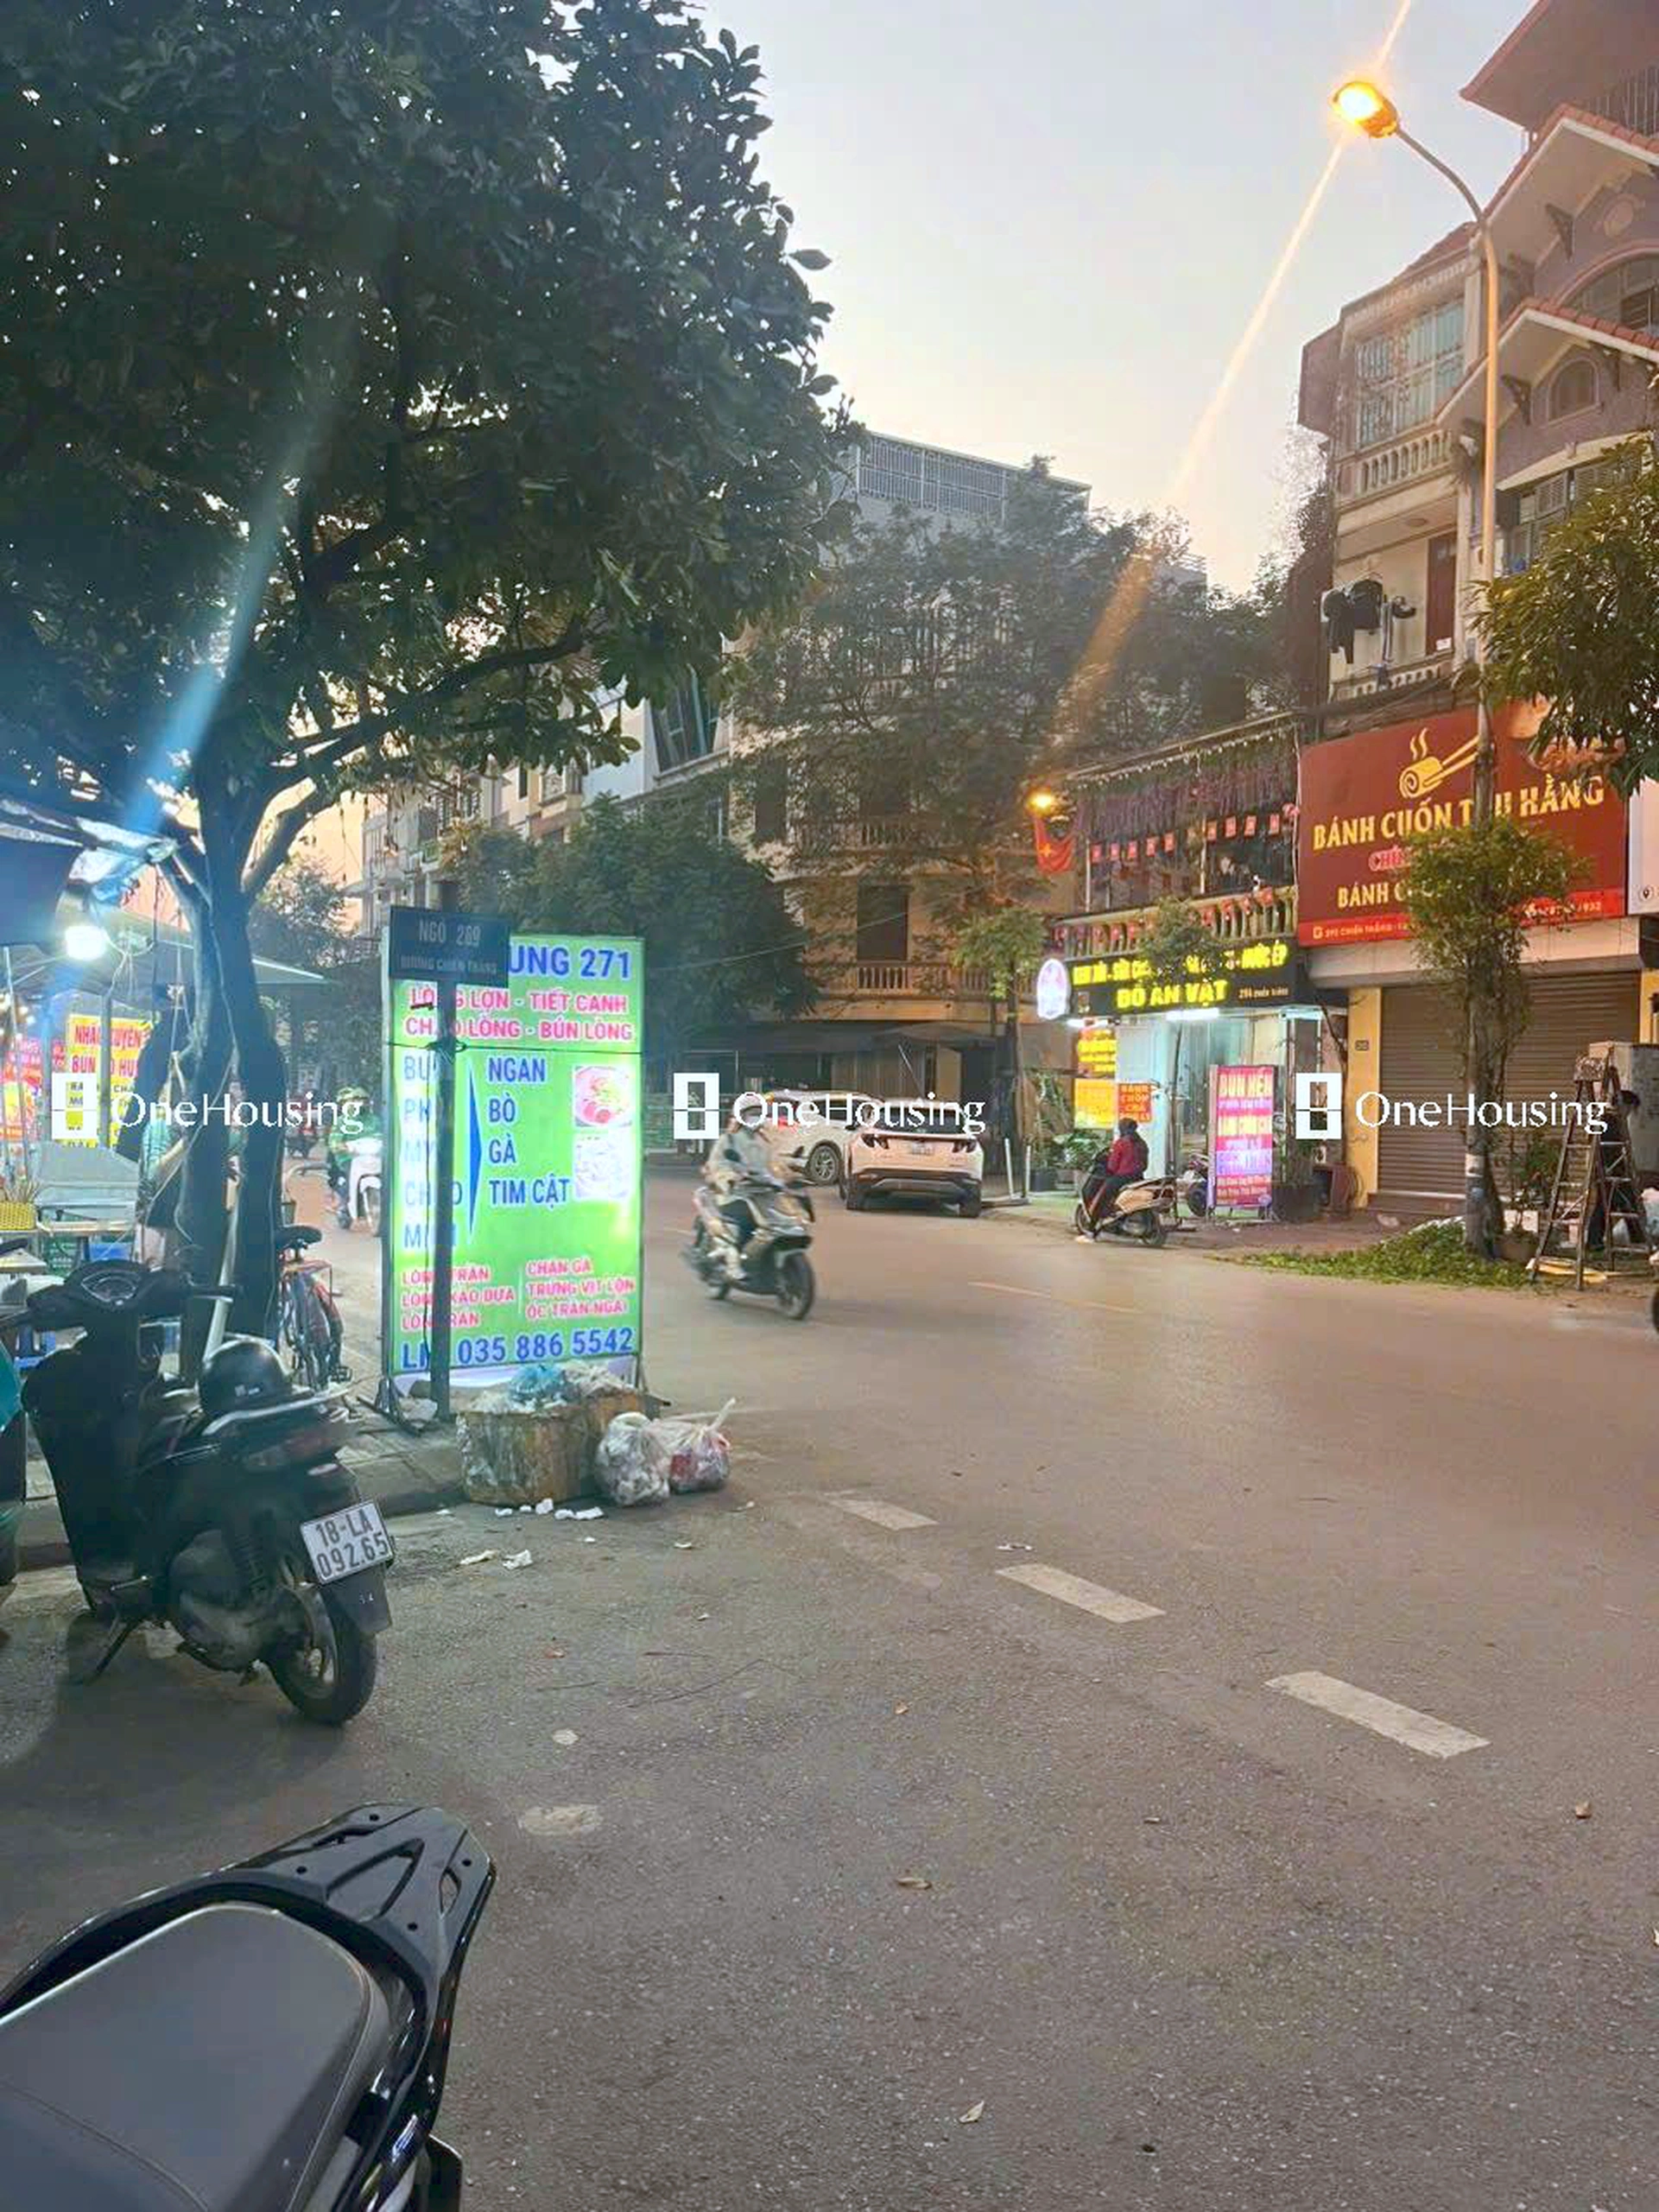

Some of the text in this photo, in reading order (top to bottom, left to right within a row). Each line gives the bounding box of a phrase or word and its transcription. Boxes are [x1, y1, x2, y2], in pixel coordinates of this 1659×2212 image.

[1313, 815, 1376, 851] BÁNH
[1381, 796, 1453, 839] CUỐN
[1338, 881, 1390, 909] BÁNH
[579, 948, 629, 978] 271
[575, 994, 627, 1012] CANH
[540, 1016, 579, 1039] BÚN
[488, 1057, 546, 1083] NGAN
[488, 1092, 516, 1123] BÒ
[488, 1133, 516, 1164] GÀ
[488, 1178, 525, 1205] TIM
[458, 1336, 506, 1365] 035
[516, 1332, 563, 1360] 886
[572, 1327, 633, 1355] 5542
[315, 1508, 373, 1548] 18-LA
[316, 1531, 389, 1578] 092.65
